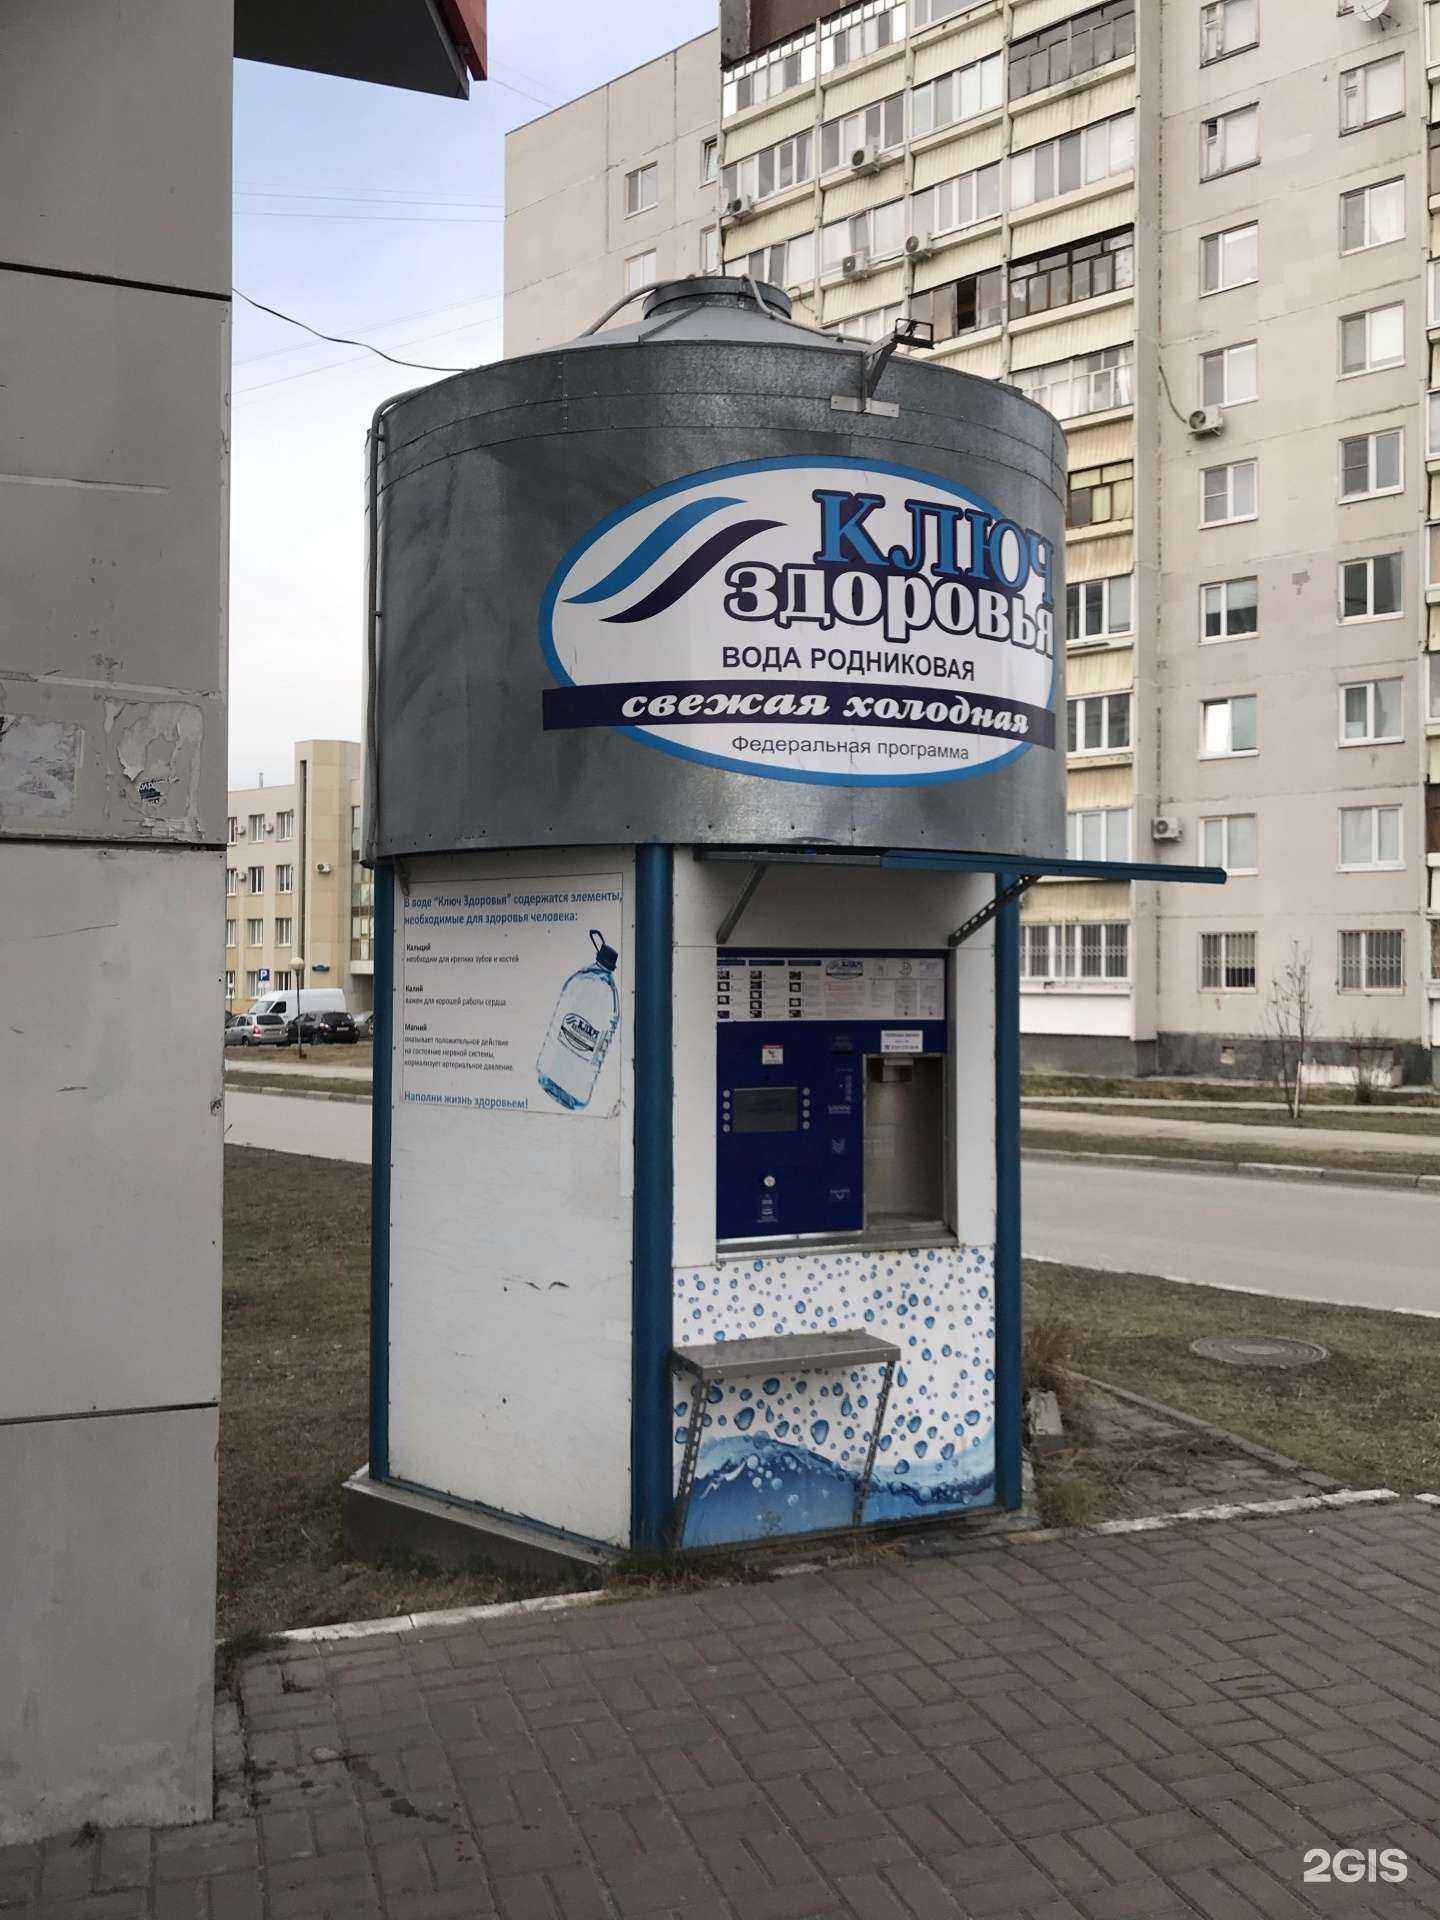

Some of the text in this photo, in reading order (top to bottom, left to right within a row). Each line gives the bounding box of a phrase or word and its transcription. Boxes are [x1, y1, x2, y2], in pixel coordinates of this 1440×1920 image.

[722, 646, 975, 681] ВОДА РОДНИКОВАЯ
[622, 691, 1031, 735] свежая холодная
[732, 736, 970, 760] Федеральная программа
[412, 898, 432, 909] воде
[514, 892, 568, 906] содержатся
[570, 891, 623, 903] элементы,
[404, 911, 578, 926] необходимые для здоровья человека:
[406, 943, 431, 952] Кальций
[404, 1023, 427, 1031] Магний
[404, 1090, 528, 1110] Наполни жизнь здоровьем!
